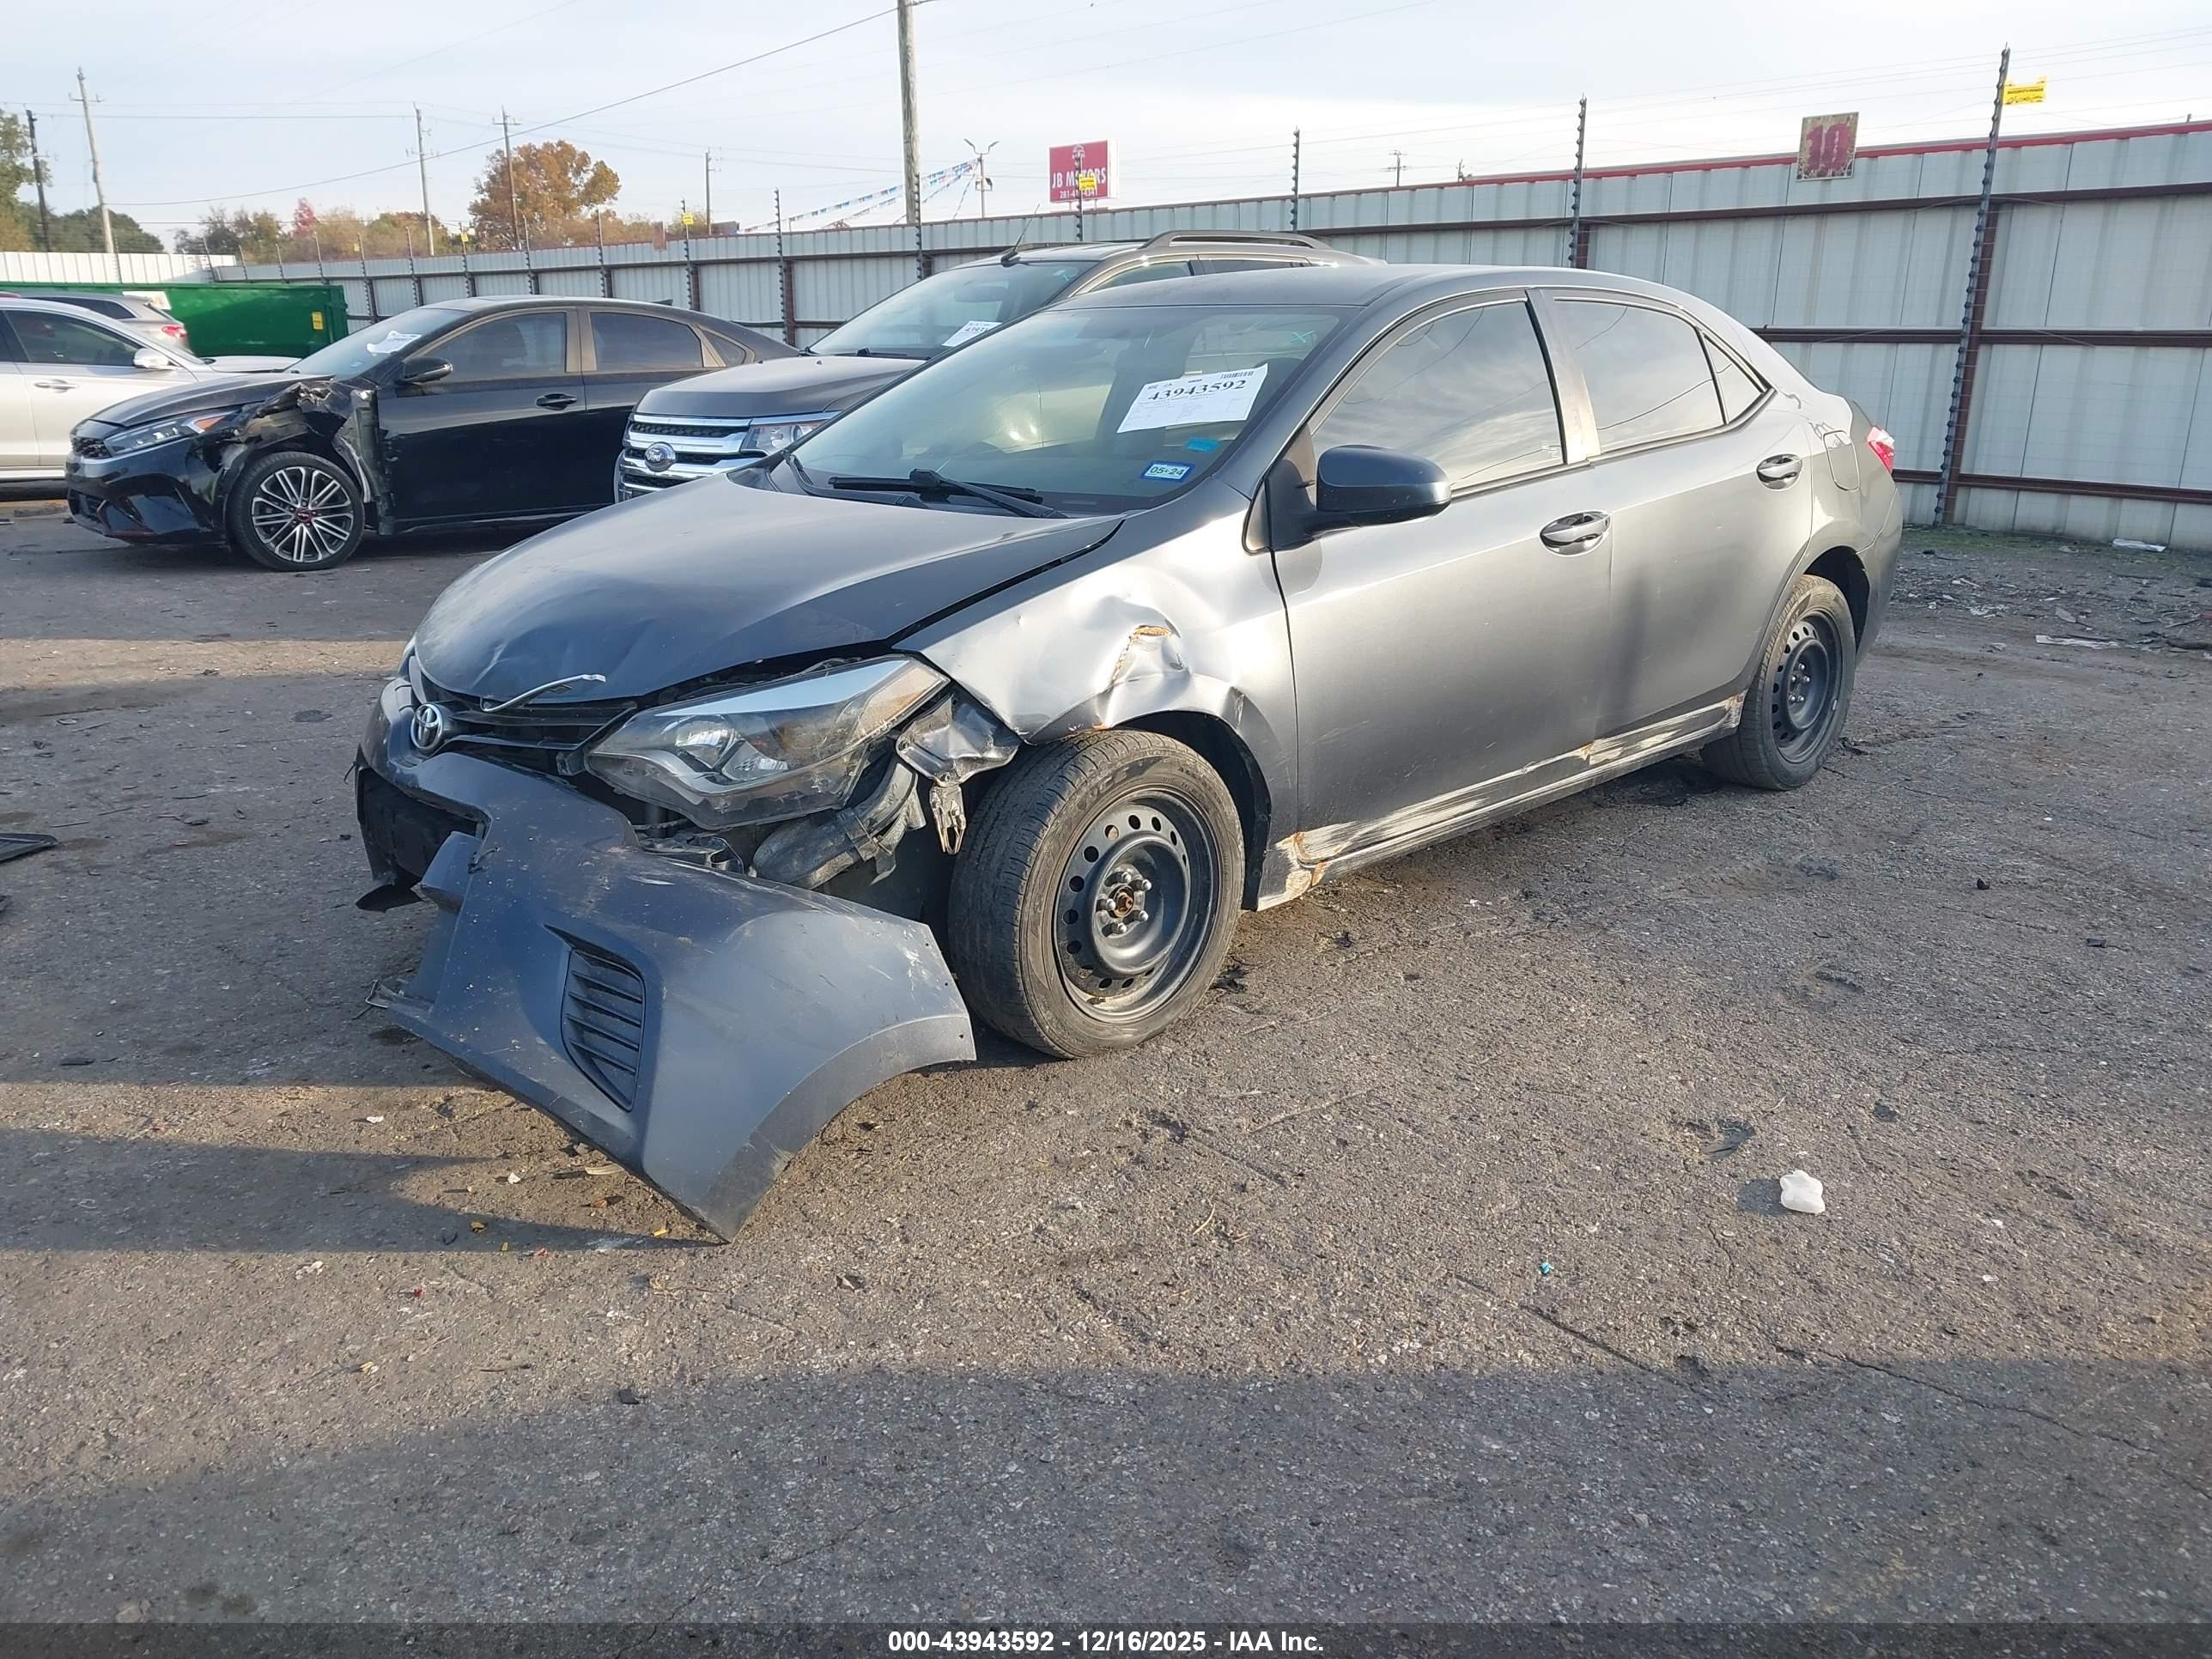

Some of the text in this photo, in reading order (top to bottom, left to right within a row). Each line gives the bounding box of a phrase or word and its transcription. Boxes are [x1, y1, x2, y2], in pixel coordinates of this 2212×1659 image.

[1806, 124, 1850, 172] 10
[1052, 172, 1063, 188] JB
[1147, 380, 1247, 402] 43943592
